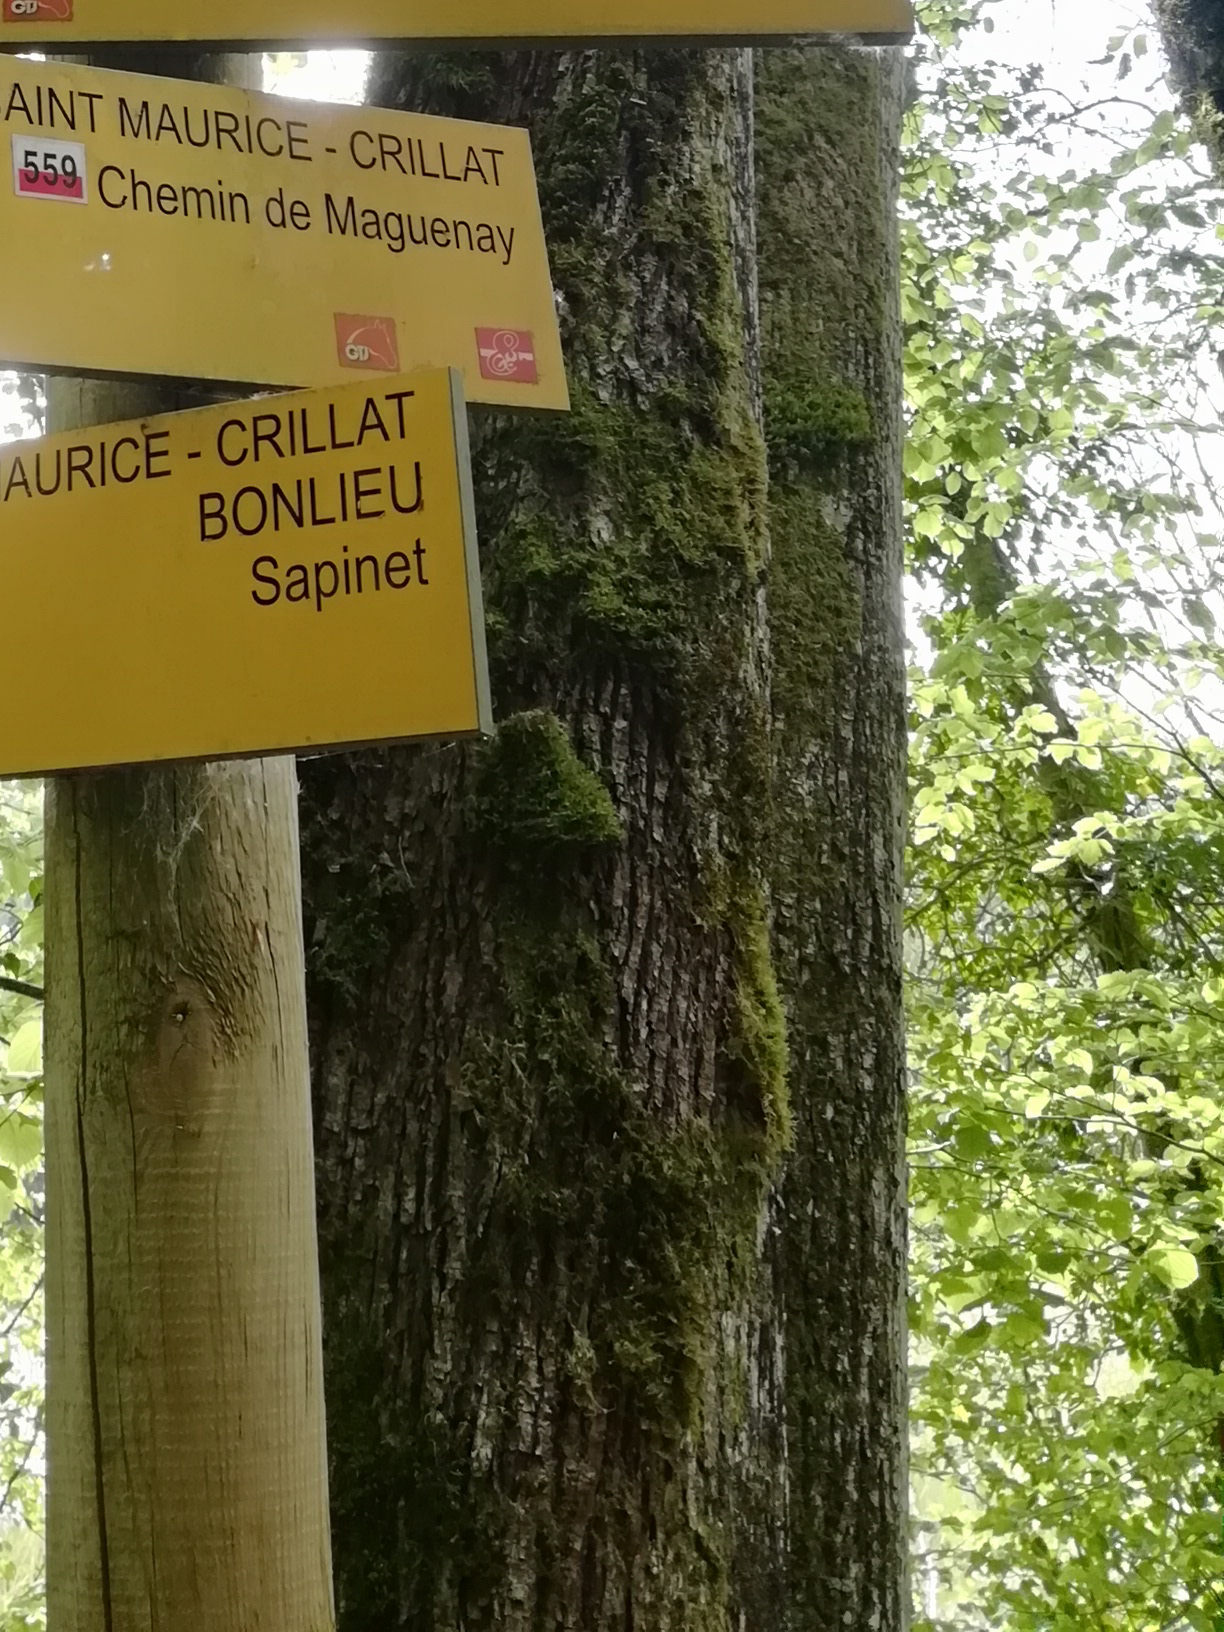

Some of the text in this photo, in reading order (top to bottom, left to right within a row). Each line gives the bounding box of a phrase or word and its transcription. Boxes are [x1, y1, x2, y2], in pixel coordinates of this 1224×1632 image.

[21, 148, 80, 190] 559
[118, 96, 313, 162] MAURICE
[349, 130, 505, 187] CRILLAT
[97, 164, 516, 266] Chemin de Maguenay
[216, 390, 416, 468] CRILLAT
[198, 461, 425, 543] BONLIEU
[251, 536, 430, 612] Sapinet
